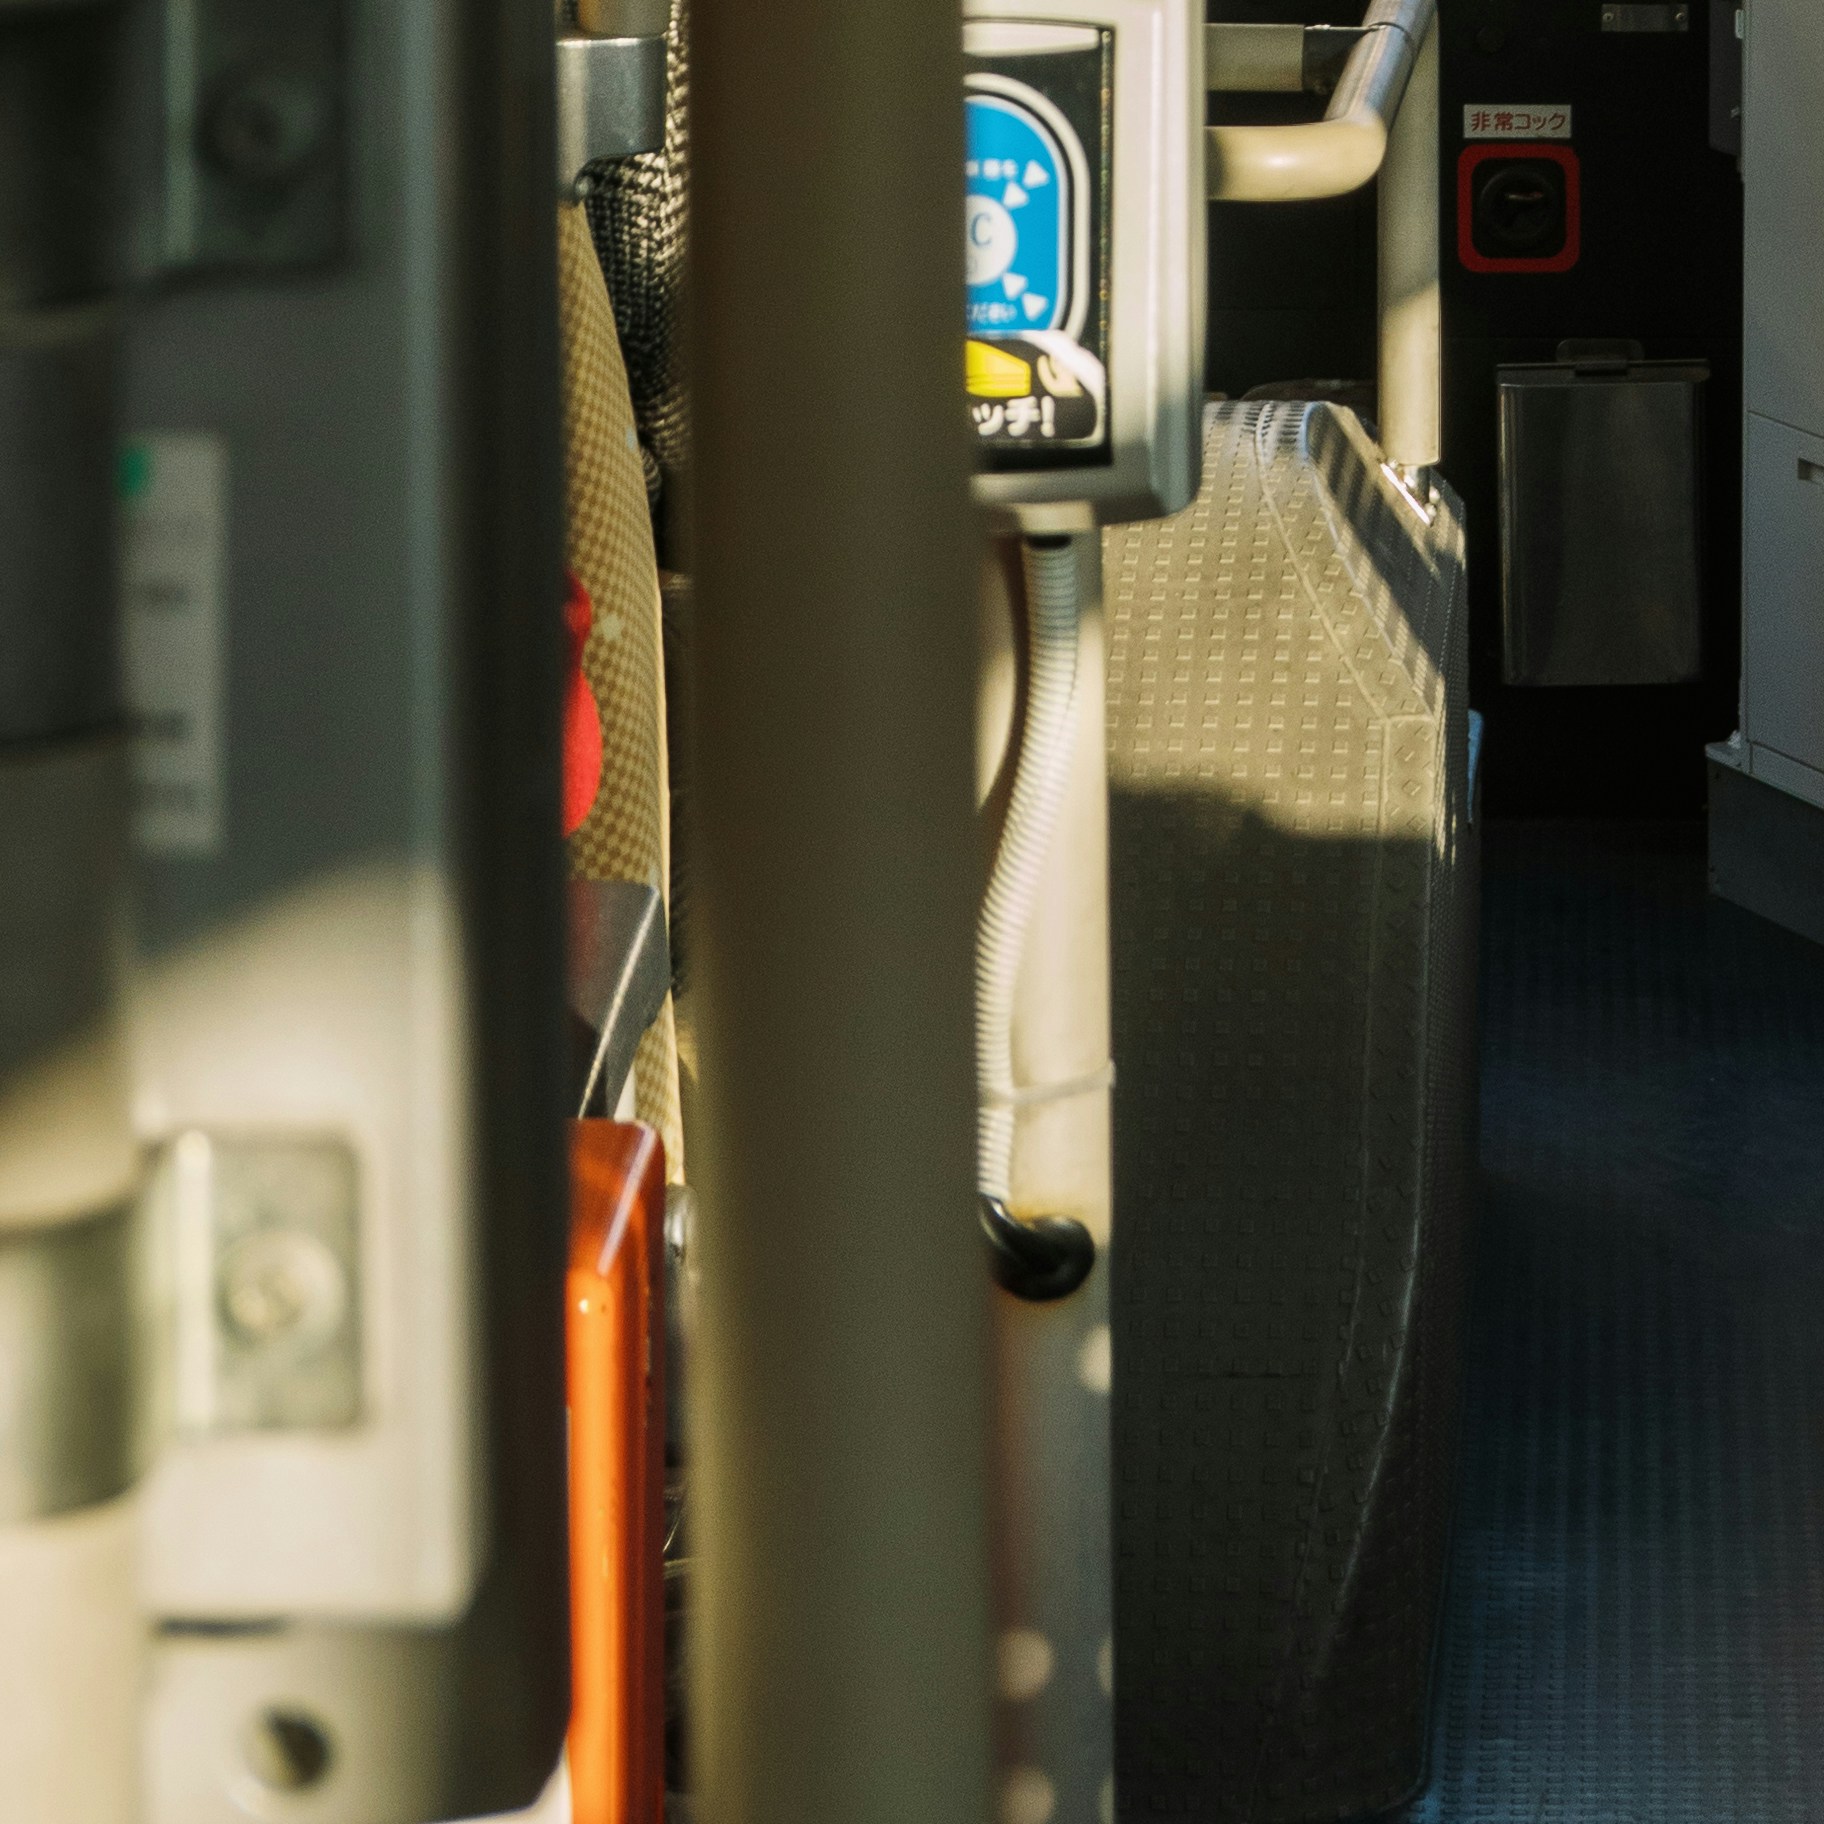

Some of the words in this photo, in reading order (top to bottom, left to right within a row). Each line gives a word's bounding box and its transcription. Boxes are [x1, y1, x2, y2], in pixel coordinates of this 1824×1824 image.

[1470, 111, 1567, 132] 非常コック
[971, 395, 1055, 438] ッチ!
